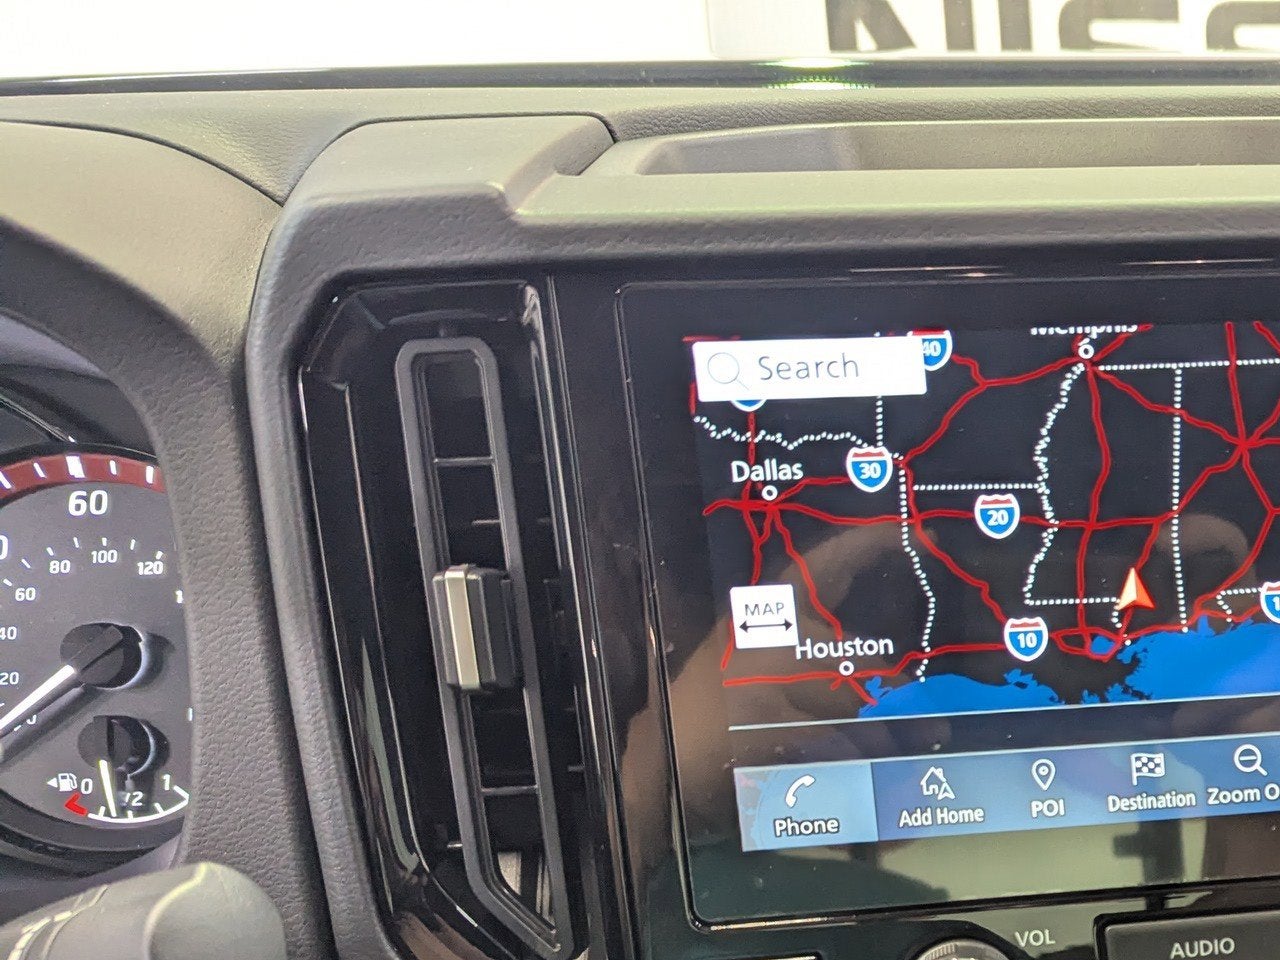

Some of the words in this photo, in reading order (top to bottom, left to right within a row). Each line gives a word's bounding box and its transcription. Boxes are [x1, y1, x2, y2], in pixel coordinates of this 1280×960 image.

[758, 352, 860, 381] Search
[731, 458, 804, 483] Dallas
[858, 462, 881, 479] 30
[68, 489, 109, 517] 60
[987, 510, 1009, 526] 20
[49, 559, 71, 574] 80
[90, 549, 118, 564] 100
[137, 561, 164, 576] 120
[15, 587, 36, 601] 60
[744, 601, 786, 617] MAP
[795, 636, 894, 660] Houston
[1017, 633, 1037, 649] 10
[1107, 788, 1196, 813] Destination
[1206, 785, 1260, 806] Zoom
[899, 809, 932, 828] Add
[936, 806, 985, 826] Home
[1030, 799, 1065, 818] POI
[773, 817, 839, 837] Phone
[1014, 928, 1056, 948] VOL
[1170, 936, 1236, 960] AUDIO
